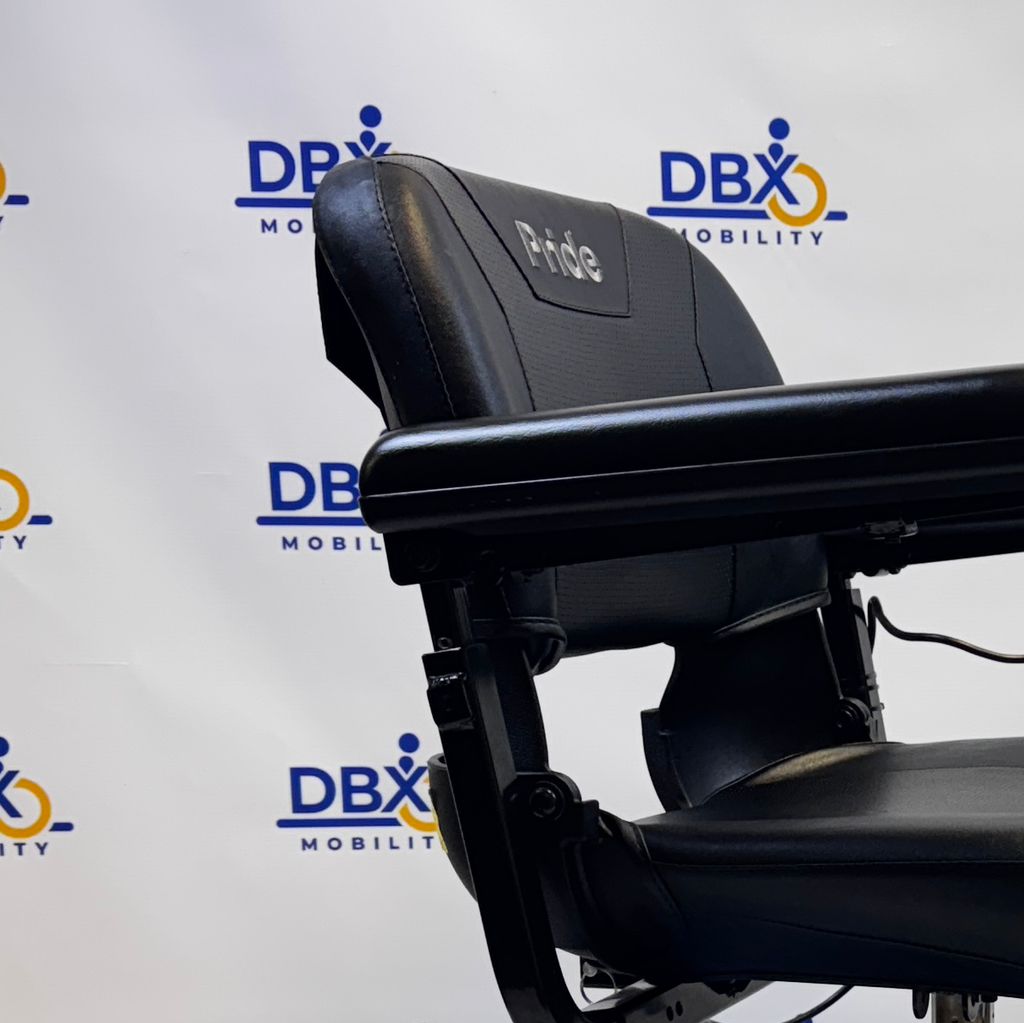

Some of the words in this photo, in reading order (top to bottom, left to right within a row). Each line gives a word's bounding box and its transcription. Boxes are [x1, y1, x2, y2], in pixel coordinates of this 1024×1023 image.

[248, 141, 392, 193] DB
[660, 151, 798, 206] DBX
[515, 219, 604, 285] Pride
[290, 766, 431, 813] DBX
